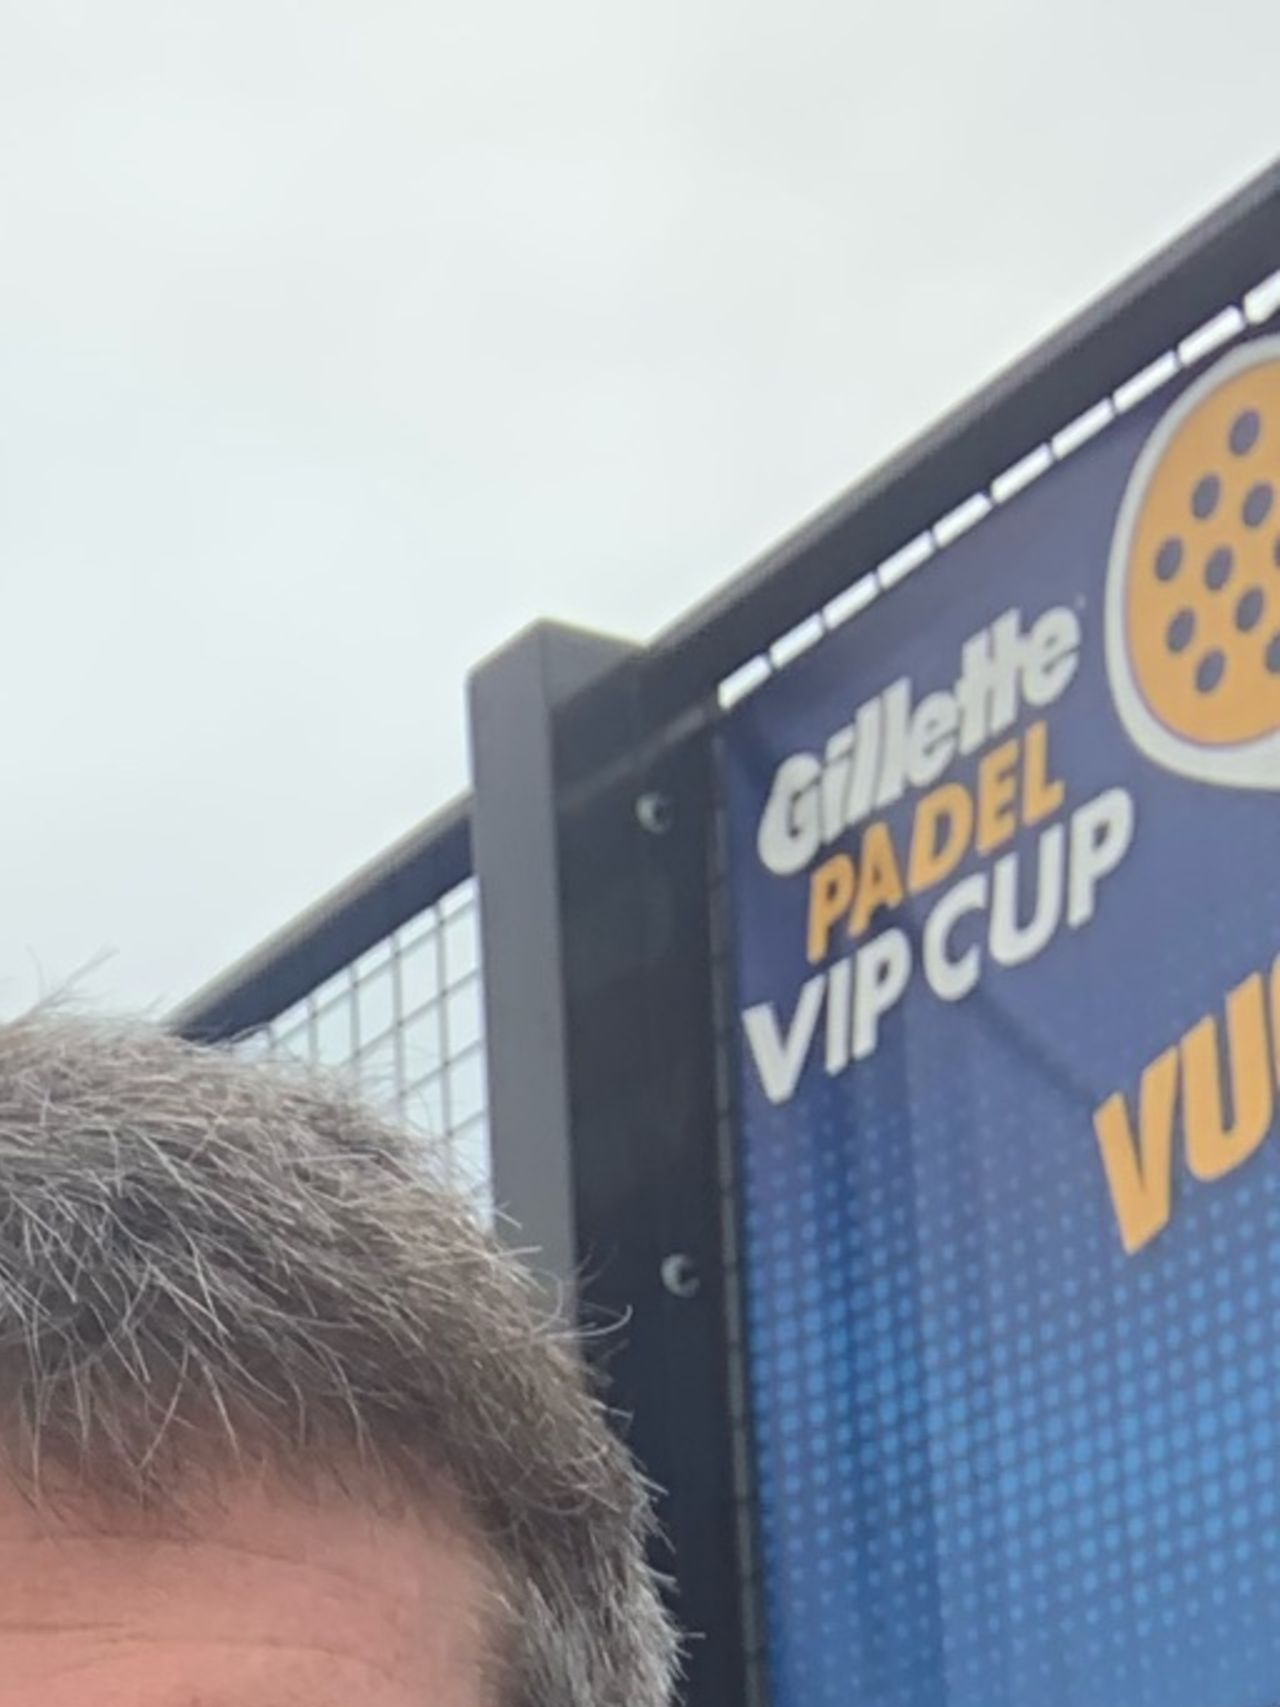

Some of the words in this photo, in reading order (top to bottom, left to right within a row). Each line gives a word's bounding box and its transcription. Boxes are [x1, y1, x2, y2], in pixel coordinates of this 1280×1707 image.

[758, 604, 1081, 876] Gillette
[806, 722, 1066, 964] PADEL
[742, 927, 913, 1105] VIP
[922, 788, 1135, 1001] CUP
[1092, 950, 1280, 1255] VU
